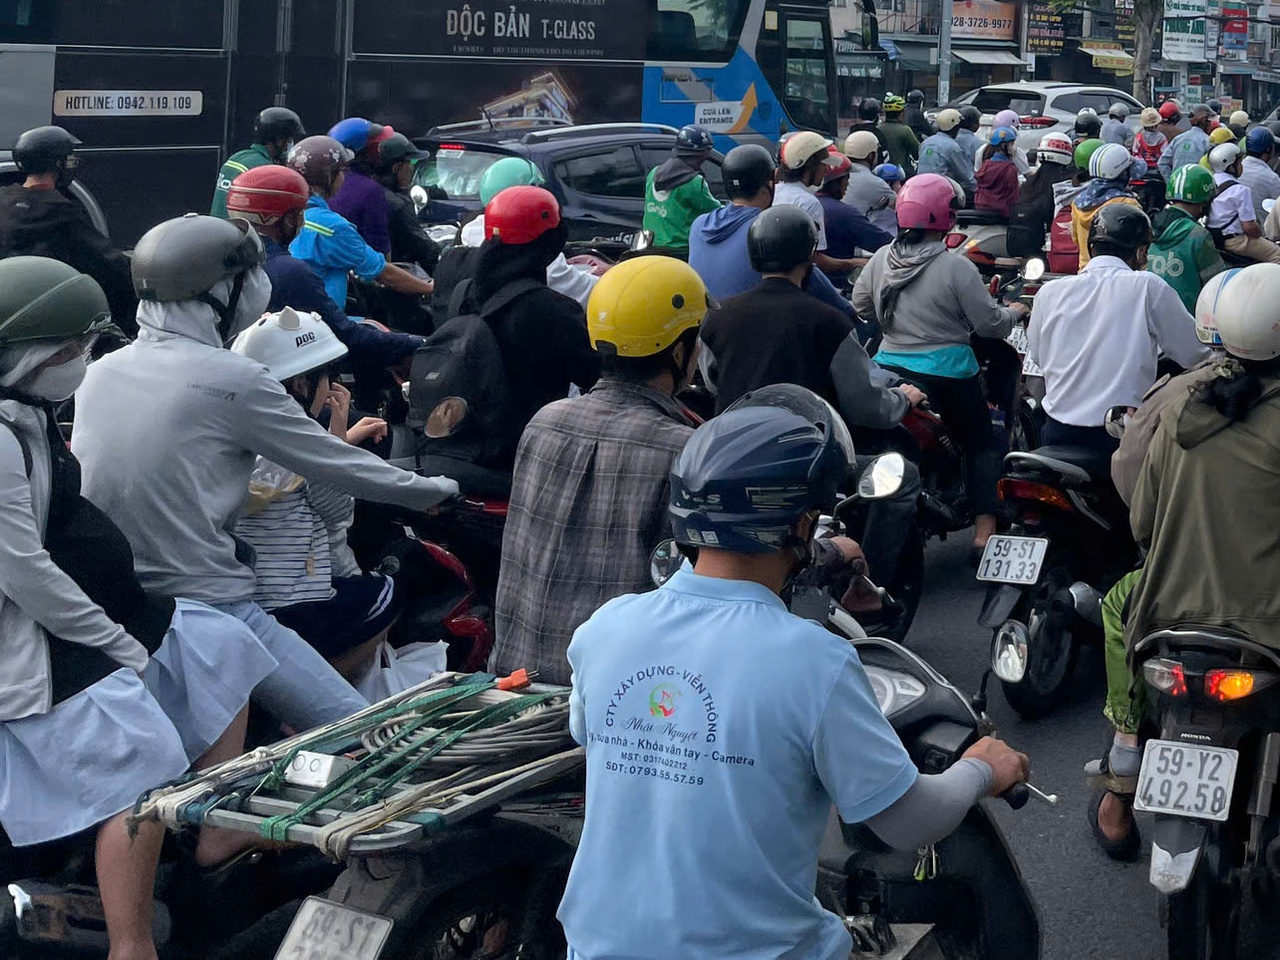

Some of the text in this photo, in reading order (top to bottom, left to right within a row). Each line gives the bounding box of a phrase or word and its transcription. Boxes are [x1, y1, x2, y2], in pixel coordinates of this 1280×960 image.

[446, 3, 596, 41] ĐỘC BẢN T-CLASS
[951, 16, 1012, 29] 28-3726-9977
[65, 96, 114, 110] HOTLINE:
[993, 539, 1036, 560] 59-S1
[982, 559, 1038, 581] 131.33
[605, 699, 618, 727] CTY
[1180, 732, 1211, 741] HONDA
[683, 747, 701, 760] tay
[711, 751, 755, 767] Camera
[1156, 746, 1223, 782] 59-Y2
[605, 760, 704, 786] SĐT: 0793.55.57.59
[1141, 776, 1225, 814] 492.58
